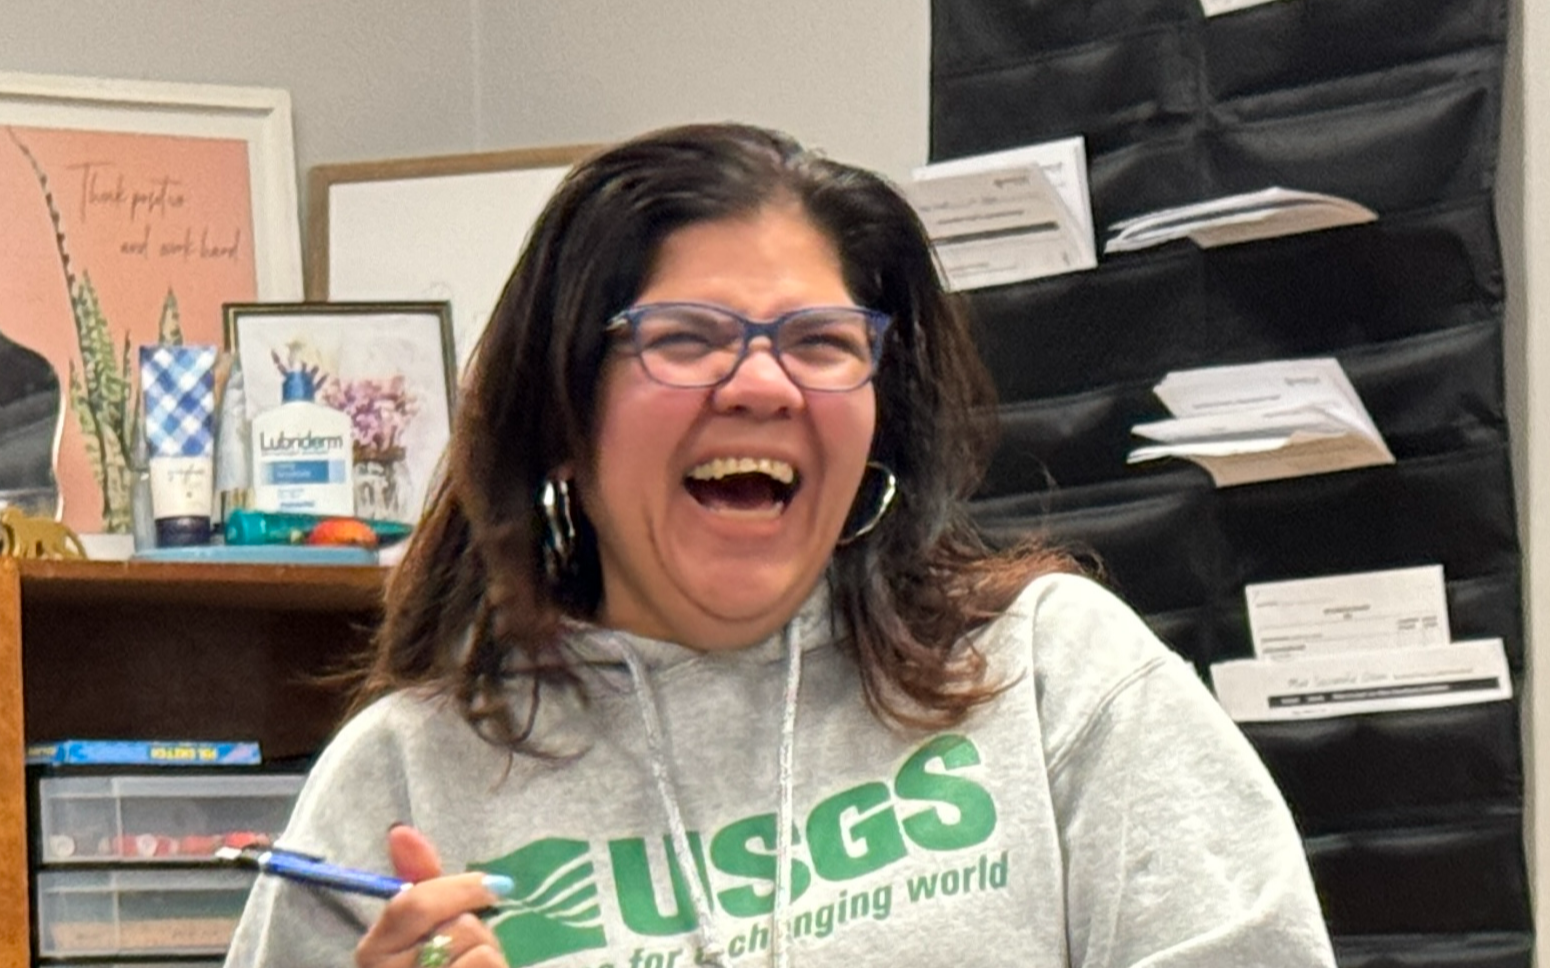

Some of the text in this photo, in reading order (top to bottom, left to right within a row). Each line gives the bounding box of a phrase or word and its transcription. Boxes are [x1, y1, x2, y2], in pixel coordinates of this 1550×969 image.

[260, 429, 343, 451] Lubriderm
[608, 733, 997, 936] USGS
[727, 884, 892, 960] chnging
[908, 851, 1009, 903] world
